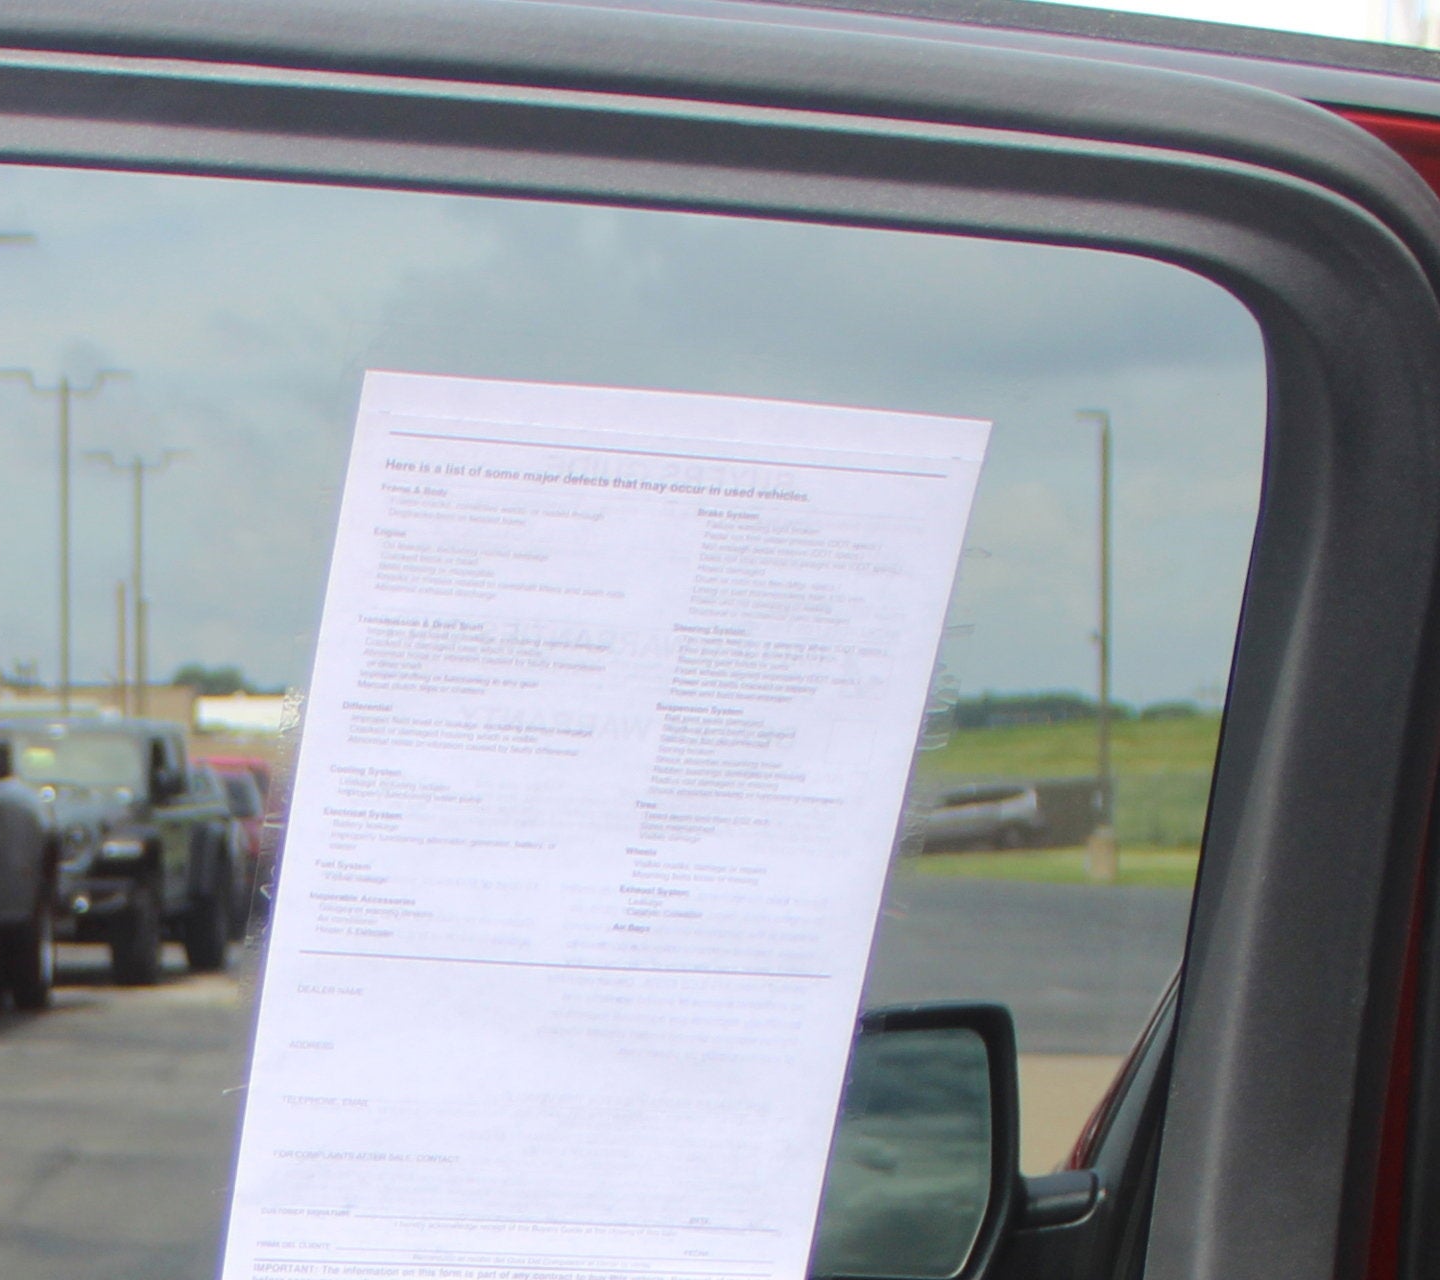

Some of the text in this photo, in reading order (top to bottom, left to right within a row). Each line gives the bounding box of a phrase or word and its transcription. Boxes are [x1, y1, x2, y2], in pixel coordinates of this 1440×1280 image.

[385, 458, 807, 501] Here is a list of some major defects that may occur in used vehicles.
[342, 701, 392, 711] Differential
[253, 1263, 313, 1272] IMPORTANT:
[323, 1265, 339, 1274] The
[343, 1267, 398, 1275] information
[418, 1268, 435, 1276] this
[439, 1268, 461, 1277] form
[477, 1271, 496, 1279] part
[512, 1272, 529, 1280] any
[575, 1273, 585, 1280] to
